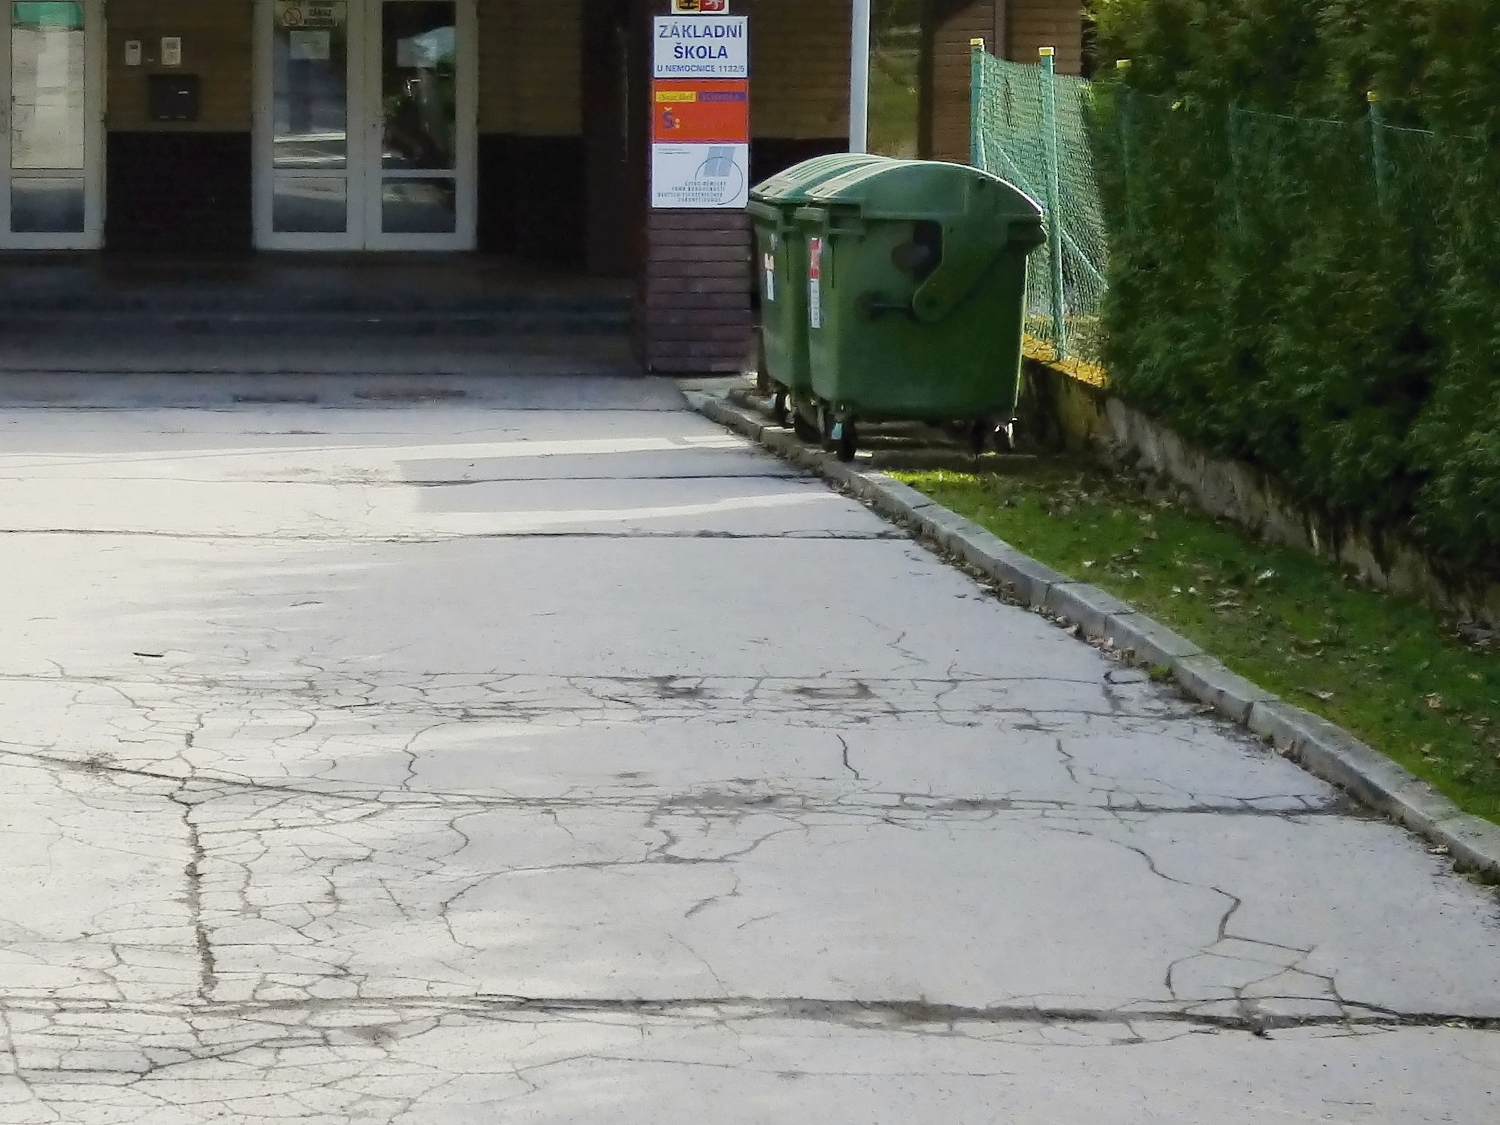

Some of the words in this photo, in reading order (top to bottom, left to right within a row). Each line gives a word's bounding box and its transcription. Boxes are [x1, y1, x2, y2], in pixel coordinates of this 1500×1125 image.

[659, 22, 743, 38] ZÁKLADNÍ
[673, 42, 729, 59] ŠKOLA
[657, 65, 663, 73] U
[665, 65, 716, 73] NEMOCNICE
[718, 65, 745, 73] 1132/5
